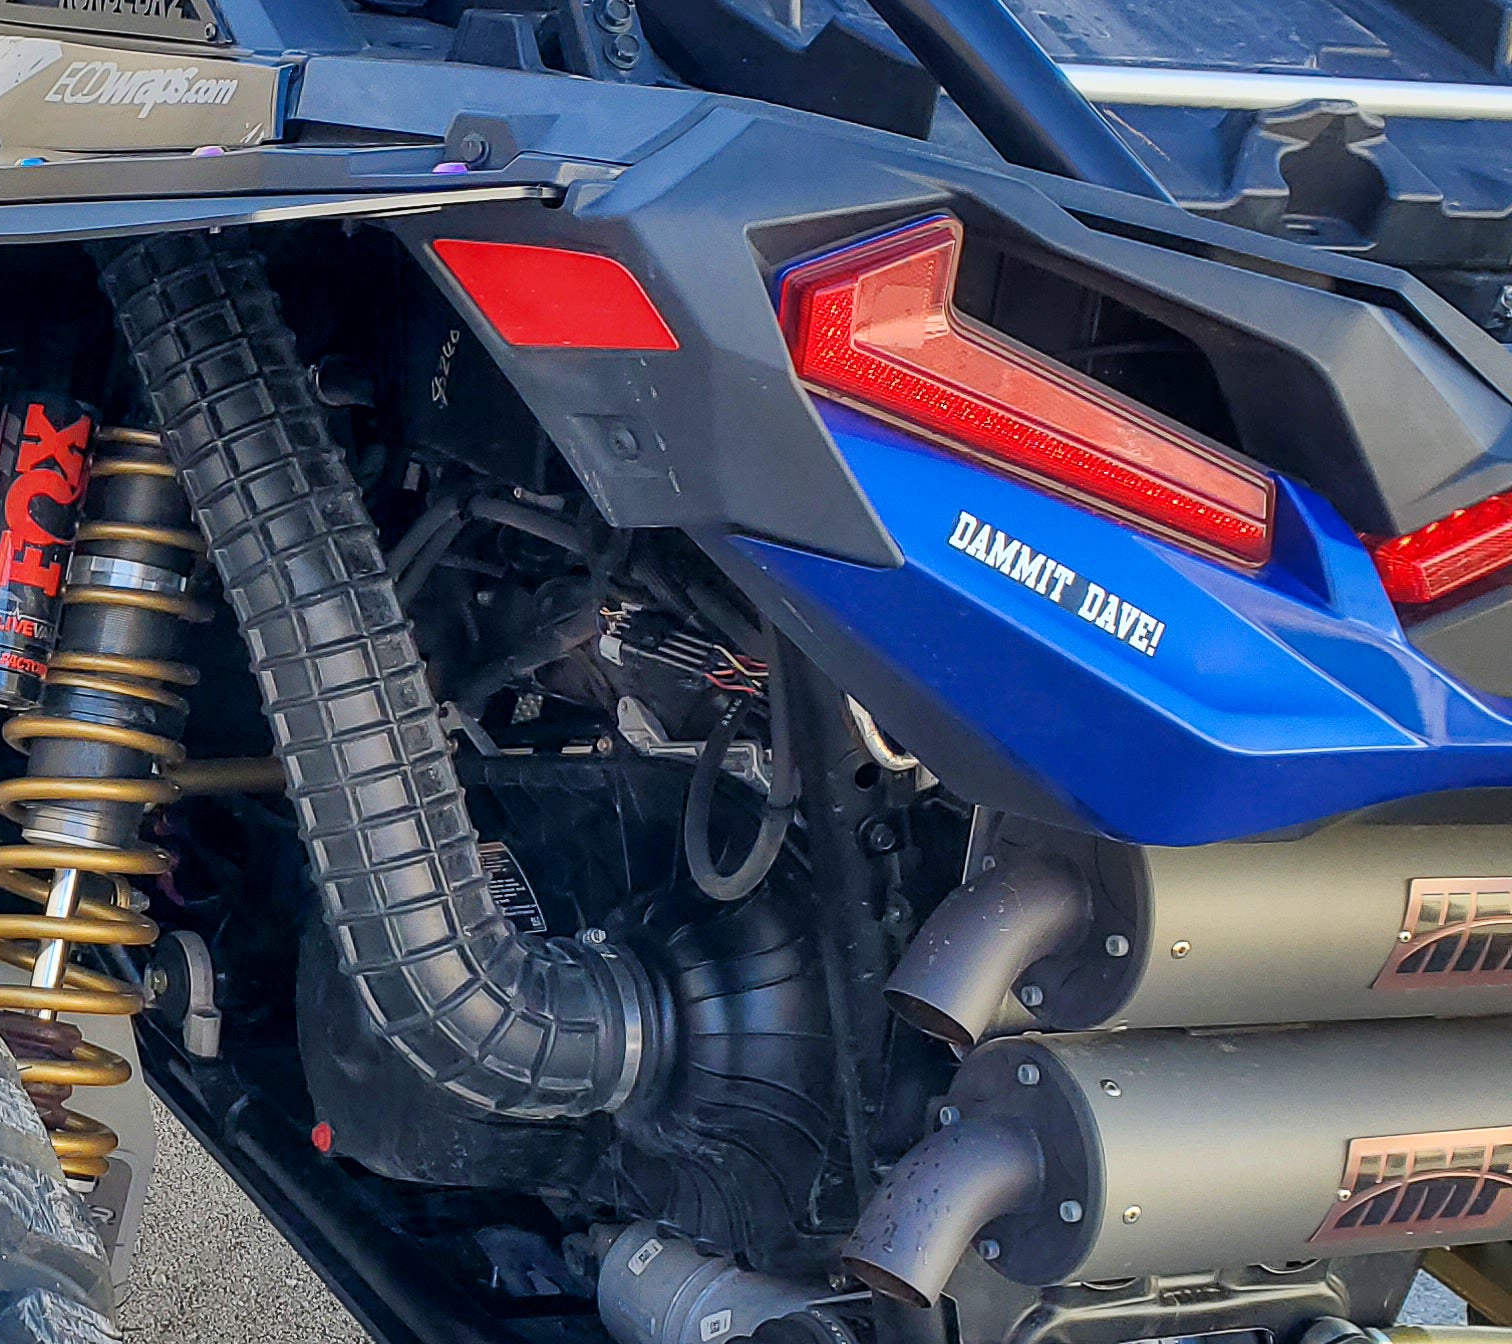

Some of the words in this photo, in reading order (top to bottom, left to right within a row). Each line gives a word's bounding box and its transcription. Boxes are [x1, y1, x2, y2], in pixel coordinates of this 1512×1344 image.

[44, 61, 238, 119] ECDwraps.com
[948, 510, 1077, 604] DAMMIT
[1077, 581, 1168, 658] DAVE!
